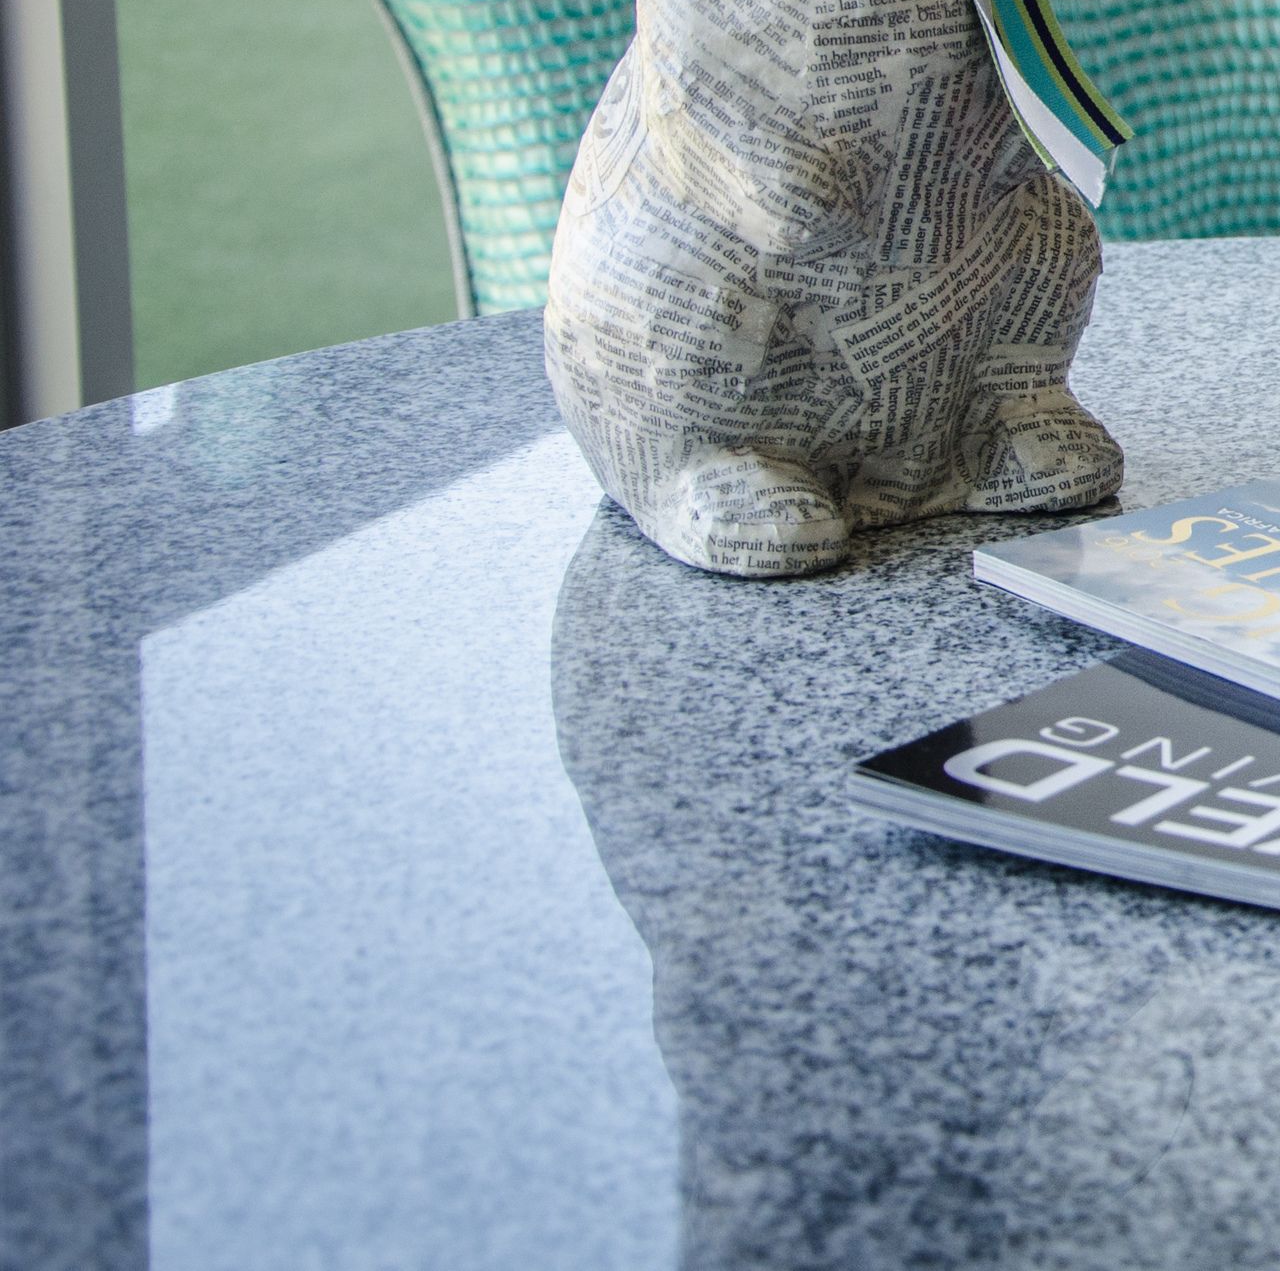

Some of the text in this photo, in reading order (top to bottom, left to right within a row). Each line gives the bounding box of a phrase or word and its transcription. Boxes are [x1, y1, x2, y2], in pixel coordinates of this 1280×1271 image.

[813, 32, 888, 47] dominansie
[841, 84, 892, 101] shirts in
[834, 100, 878, 119] instead
[840, 118, 872, 134] night
